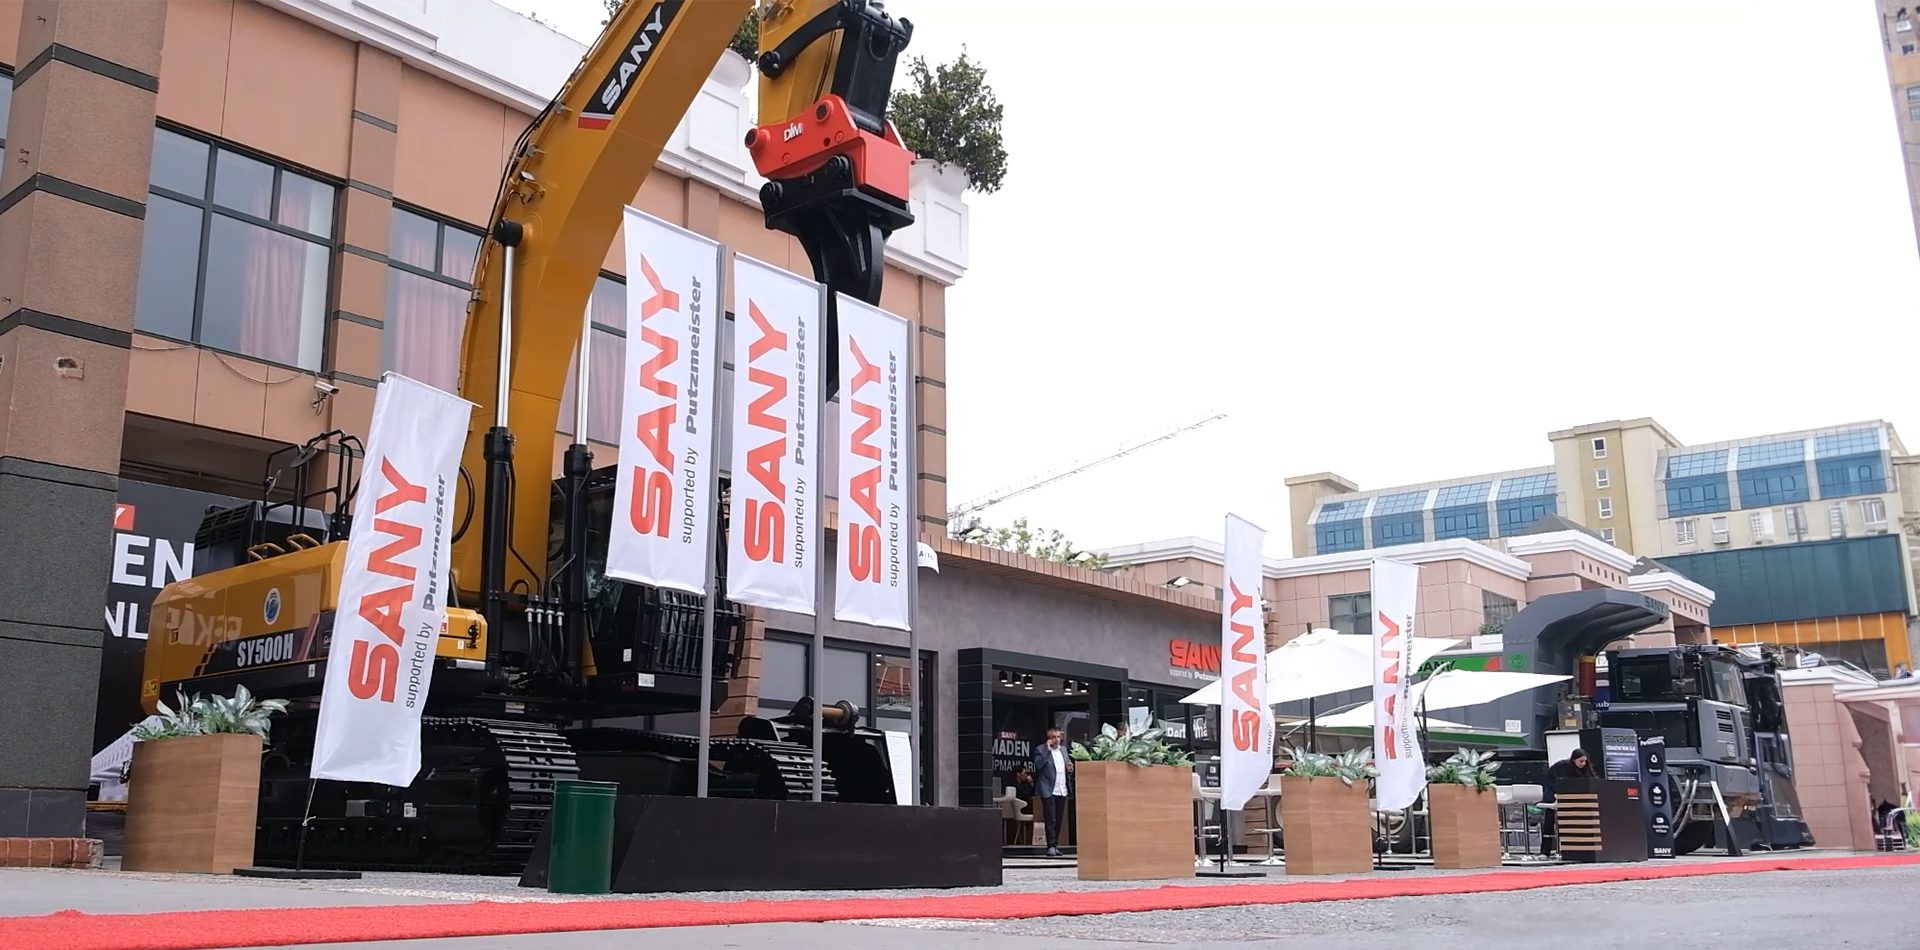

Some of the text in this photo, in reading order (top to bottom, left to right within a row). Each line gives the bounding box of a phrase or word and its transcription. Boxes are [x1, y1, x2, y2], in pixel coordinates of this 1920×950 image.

[602, 5, 663, 111] SANY
[630, 252, 680, 538] SANY
[682, 276, 701, 544] supported by Putzmeister
[743, 297, 788, 563] SANY
[794, 316, 807, 568] supported by Putzmeister
[848, 333, 882, 584] SANY
[888, 350, 900, 588] supported by Putzmeister
[236, 632, 294, 668] SY500H
[348, 455, 428, 703] SANY
[405, 474, 446, 708] supported by Putzmeister
[1229, 575, 1261, 753] SANY
[1001, 731, 1017, 739] SANY
